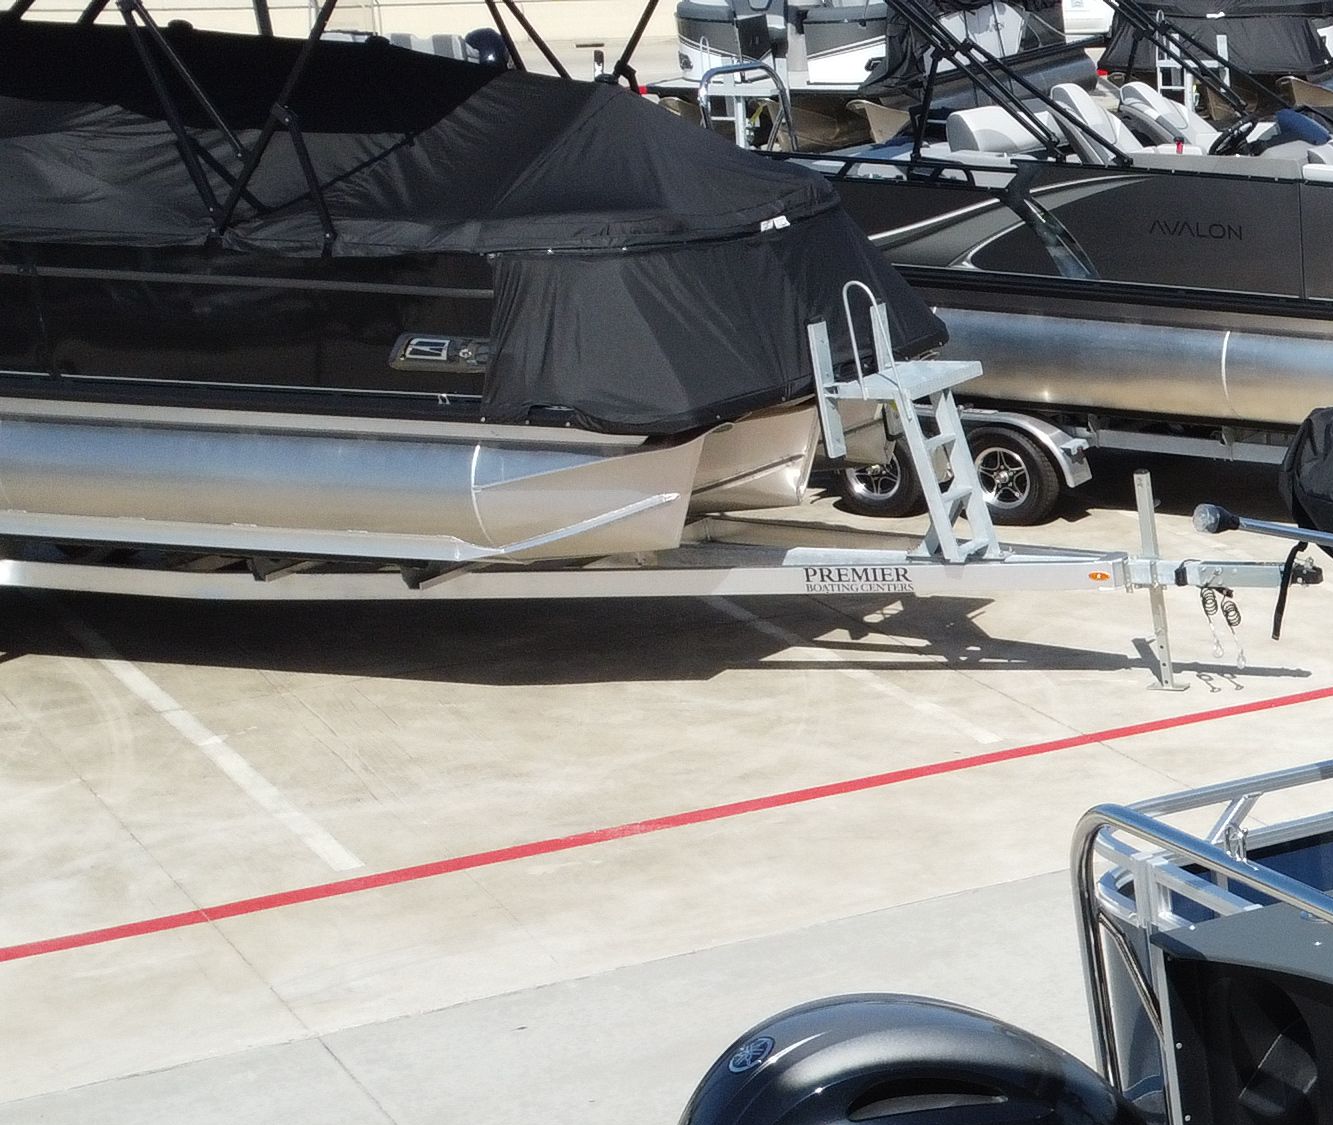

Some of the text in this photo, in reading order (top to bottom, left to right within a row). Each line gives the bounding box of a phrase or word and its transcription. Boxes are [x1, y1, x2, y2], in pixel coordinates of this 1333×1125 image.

[1149, 219, 1243, 240] AVALON
[803, 567, 912, 582] PREMIER
[806, 583, 914, 592] BOATING CENTERS
